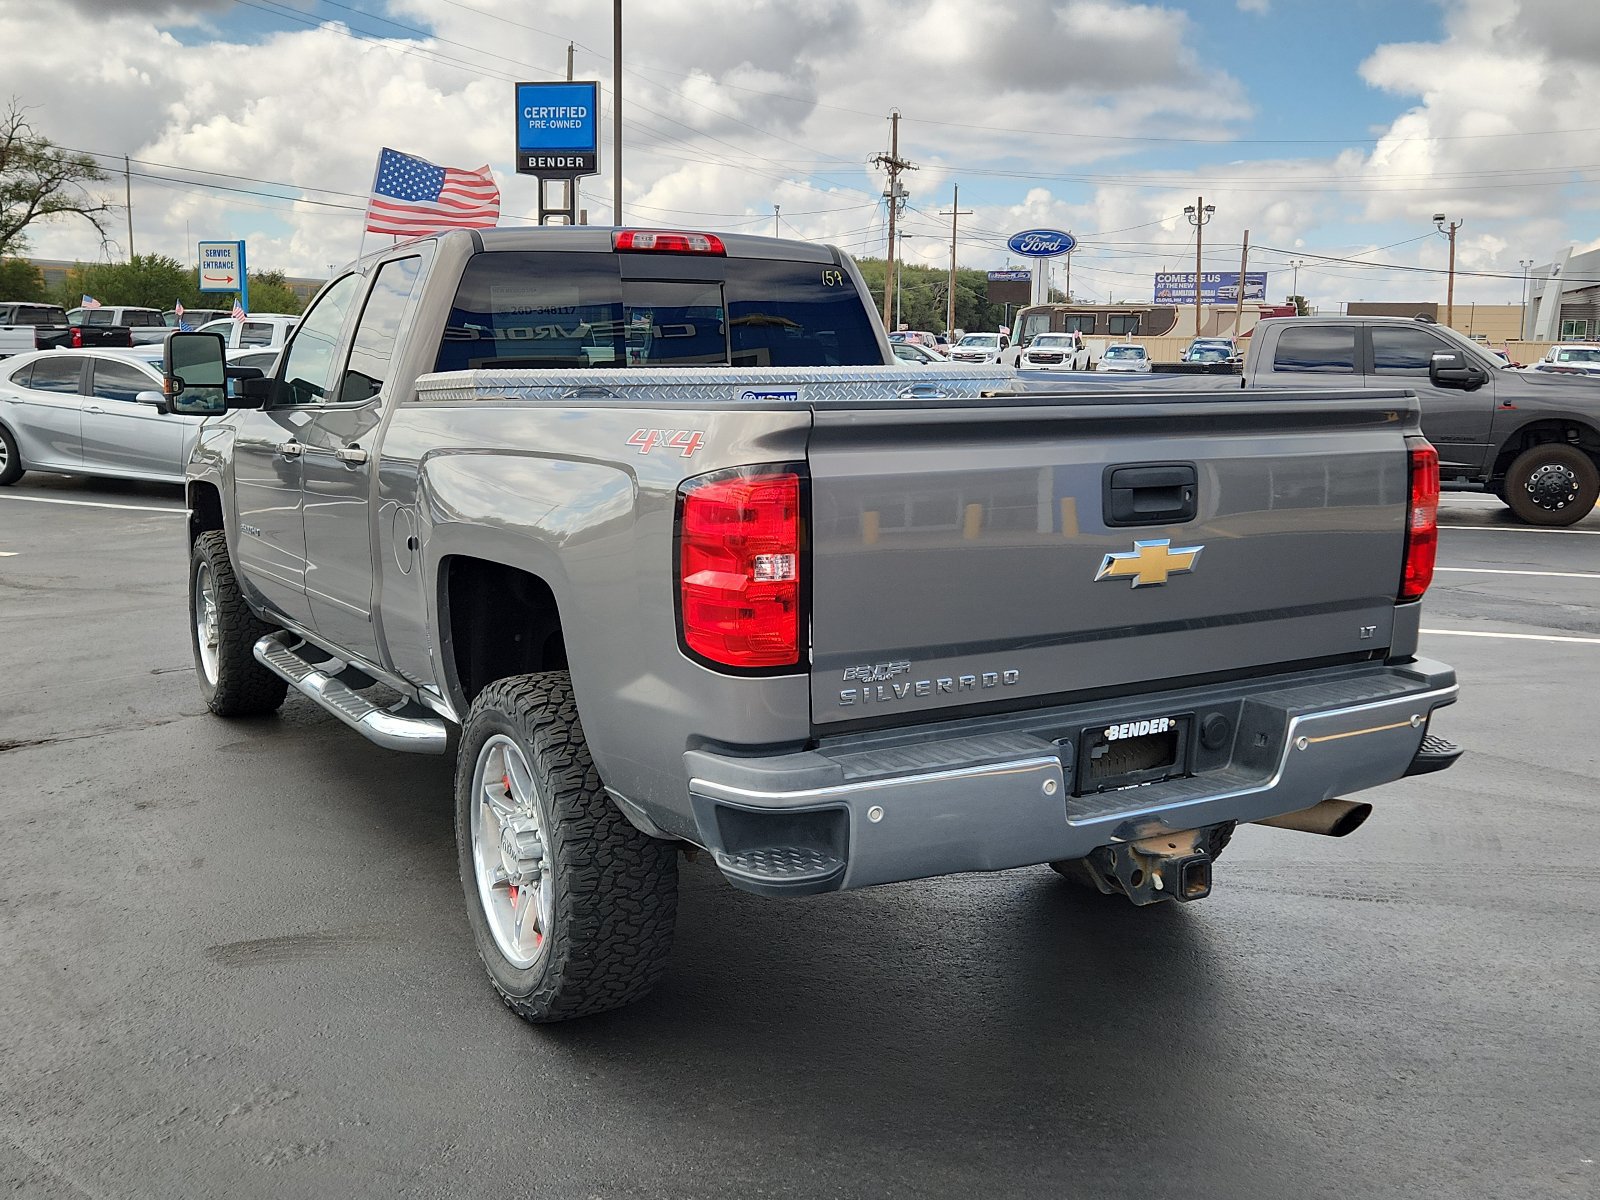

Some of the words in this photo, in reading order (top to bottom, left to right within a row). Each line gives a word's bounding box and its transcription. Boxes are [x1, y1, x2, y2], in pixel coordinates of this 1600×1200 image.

[524, 106, 587, 119] CERTIFIED
[529, 120, 582, 129] PRE-OWNED
[528, 157, 584, 167] BENDER
[1020, 234, 1062, 252] Ford
[205, 249, 231, 257] SERVICE
[203, 261, 234, 269] ENTRANCE
[821, 270, 843, 287] 157
[1157, 274, 1187, 283] COME
[1207, 274, 1221, 283] US
[1360, 625, 1377, 640] LT
[843, 660, 912, 682] BENDER
[839, 669, 1020, 706] SILVERADO
[1107, 717, 1170, 741] BENDER
